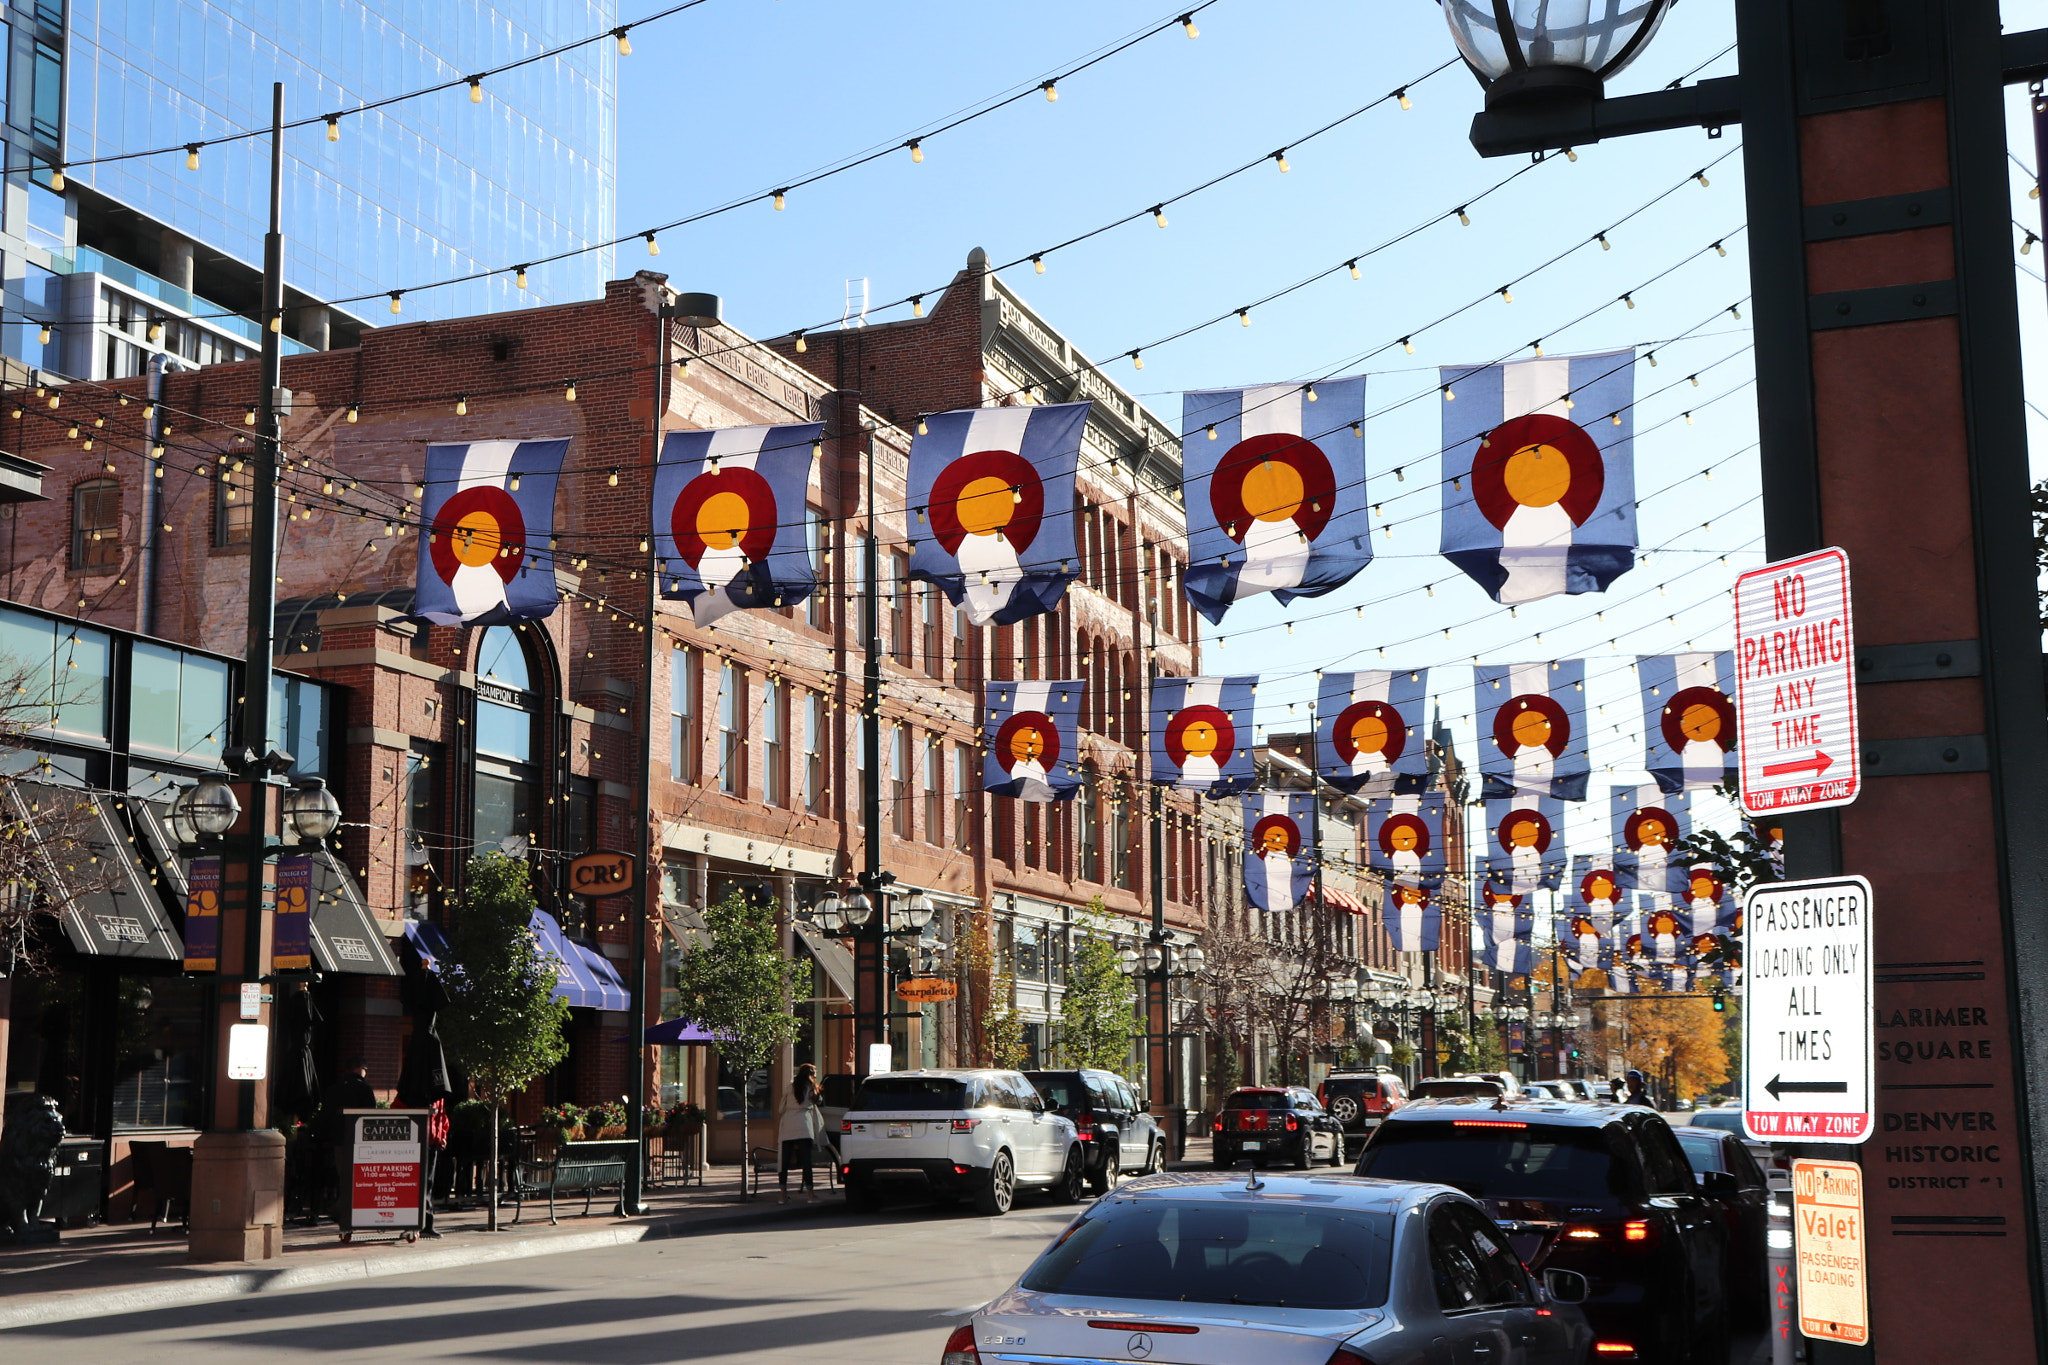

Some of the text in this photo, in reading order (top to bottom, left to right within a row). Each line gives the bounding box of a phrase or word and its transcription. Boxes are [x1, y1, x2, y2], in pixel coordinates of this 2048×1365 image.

[746, 362, 770, 391] BROS
[1774, 573, 1805, 622] NO
[1744, 617, 1843, 680] PARKING
[1773, 676, 1816, 714] ANY
[1772, 714, 1822, 750] TIME
[1750, 780, 1850, 809] TOW AWAY ZONE
[576, 859, 627, 885] CRU
[188, 890, 218, 917] 50
[277, 886, 307, 914] 50
[1755, 896, 1858, 932] PASSENGER
[102, 924, 144, 935] CAPITAL
[335, 944, 370, 954] CAPITAL
[1755, 944, 1858, 978] LOADING ONLY
[1788, 986, 1822, 1016] ALL
[1876, 1007, 1988, 1028] LARIMER
[1778, 1029, 1832, 1061] TIMES
[1878, 1040, 1992, 1064] SQUARE
[363, 1126, 410, 1135] CAPITAL
[1753, 1115, 1860, 1134] TOW AWAY ZONE
[1883, 1112, 1997, 1132] DENVER
[1886, 1145, 2001, 1163] HISTORIC
[1797, 1170, 1858, 1198] NO PARKING
[1888, 1176, 1970, 1189] DISTRICT
[1803, 1209, 1857, 1241] Valet
[1801, 1251, 1860, 1271] PASSENGER
[1808, 1269, 1855, 1288] LOADING
[1805, 1320, 1820, 1332] TOW
[1844, 1327, 1863, 1340] ZONE
